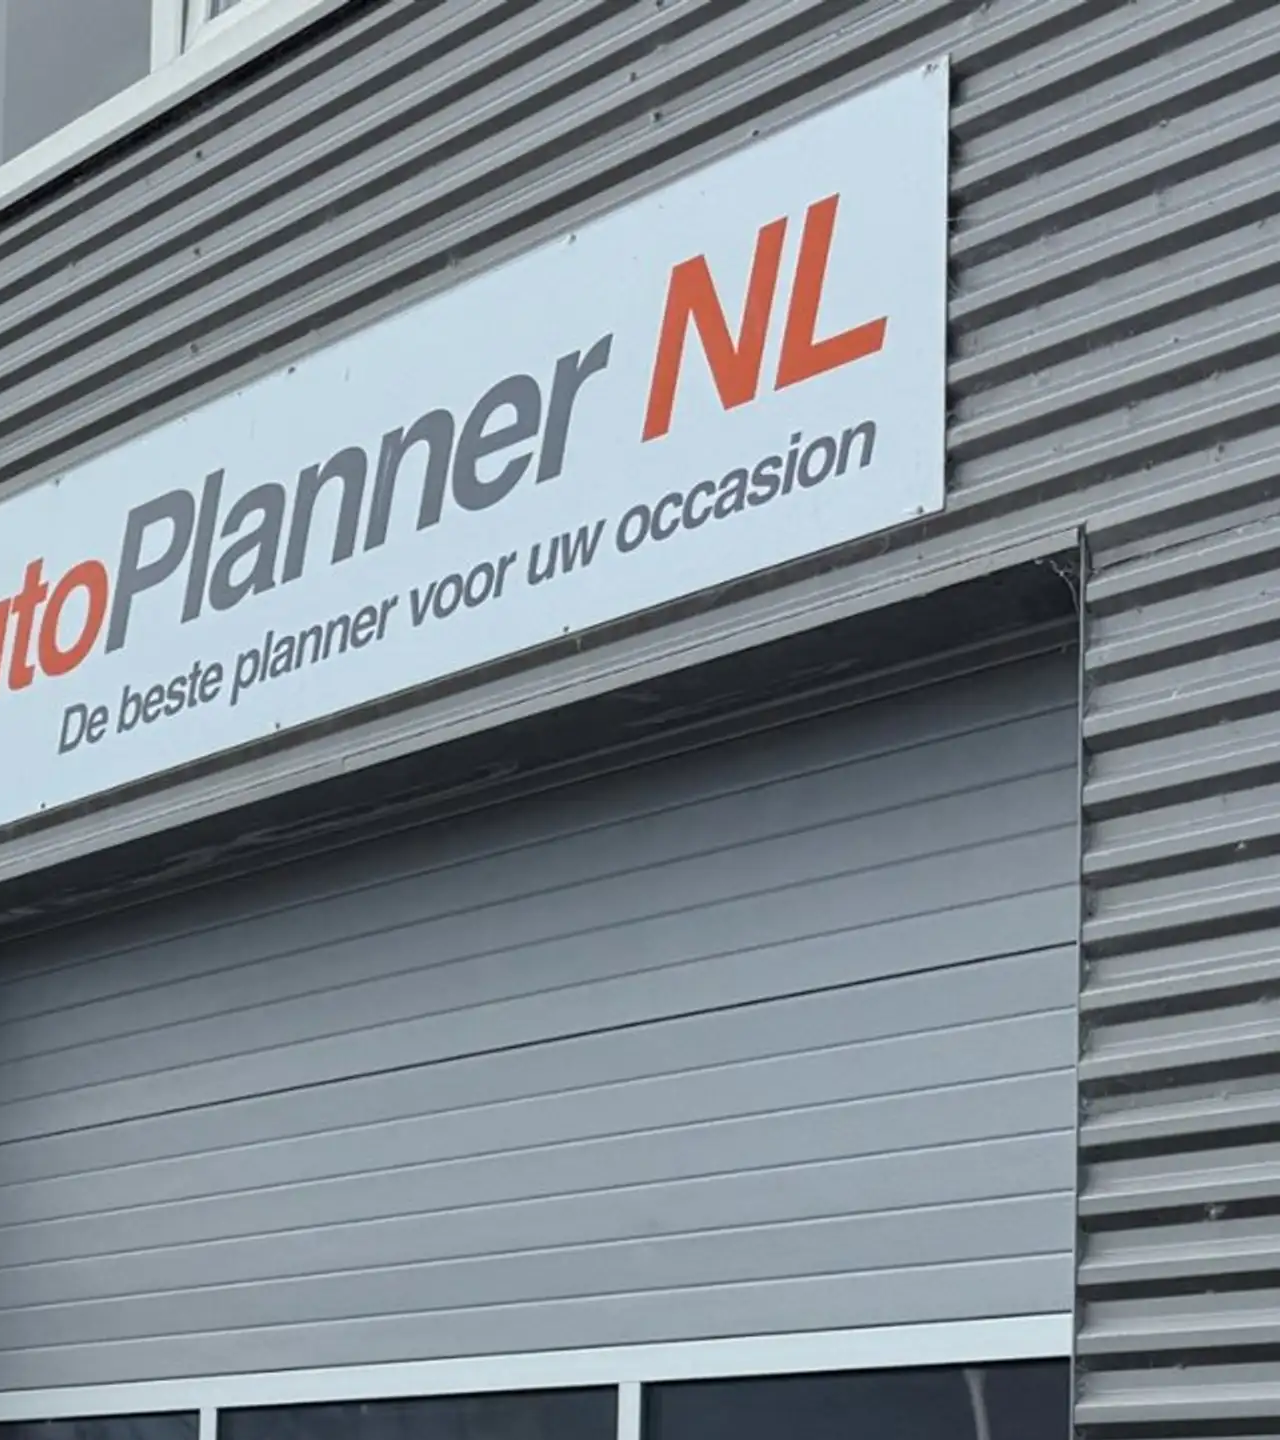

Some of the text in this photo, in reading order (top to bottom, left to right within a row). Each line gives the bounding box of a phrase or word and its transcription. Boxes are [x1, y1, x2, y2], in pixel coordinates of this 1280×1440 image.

[641, 192, 889, 443] NL
[57, 419, 877, 755] De beste planner voor uw occasion
